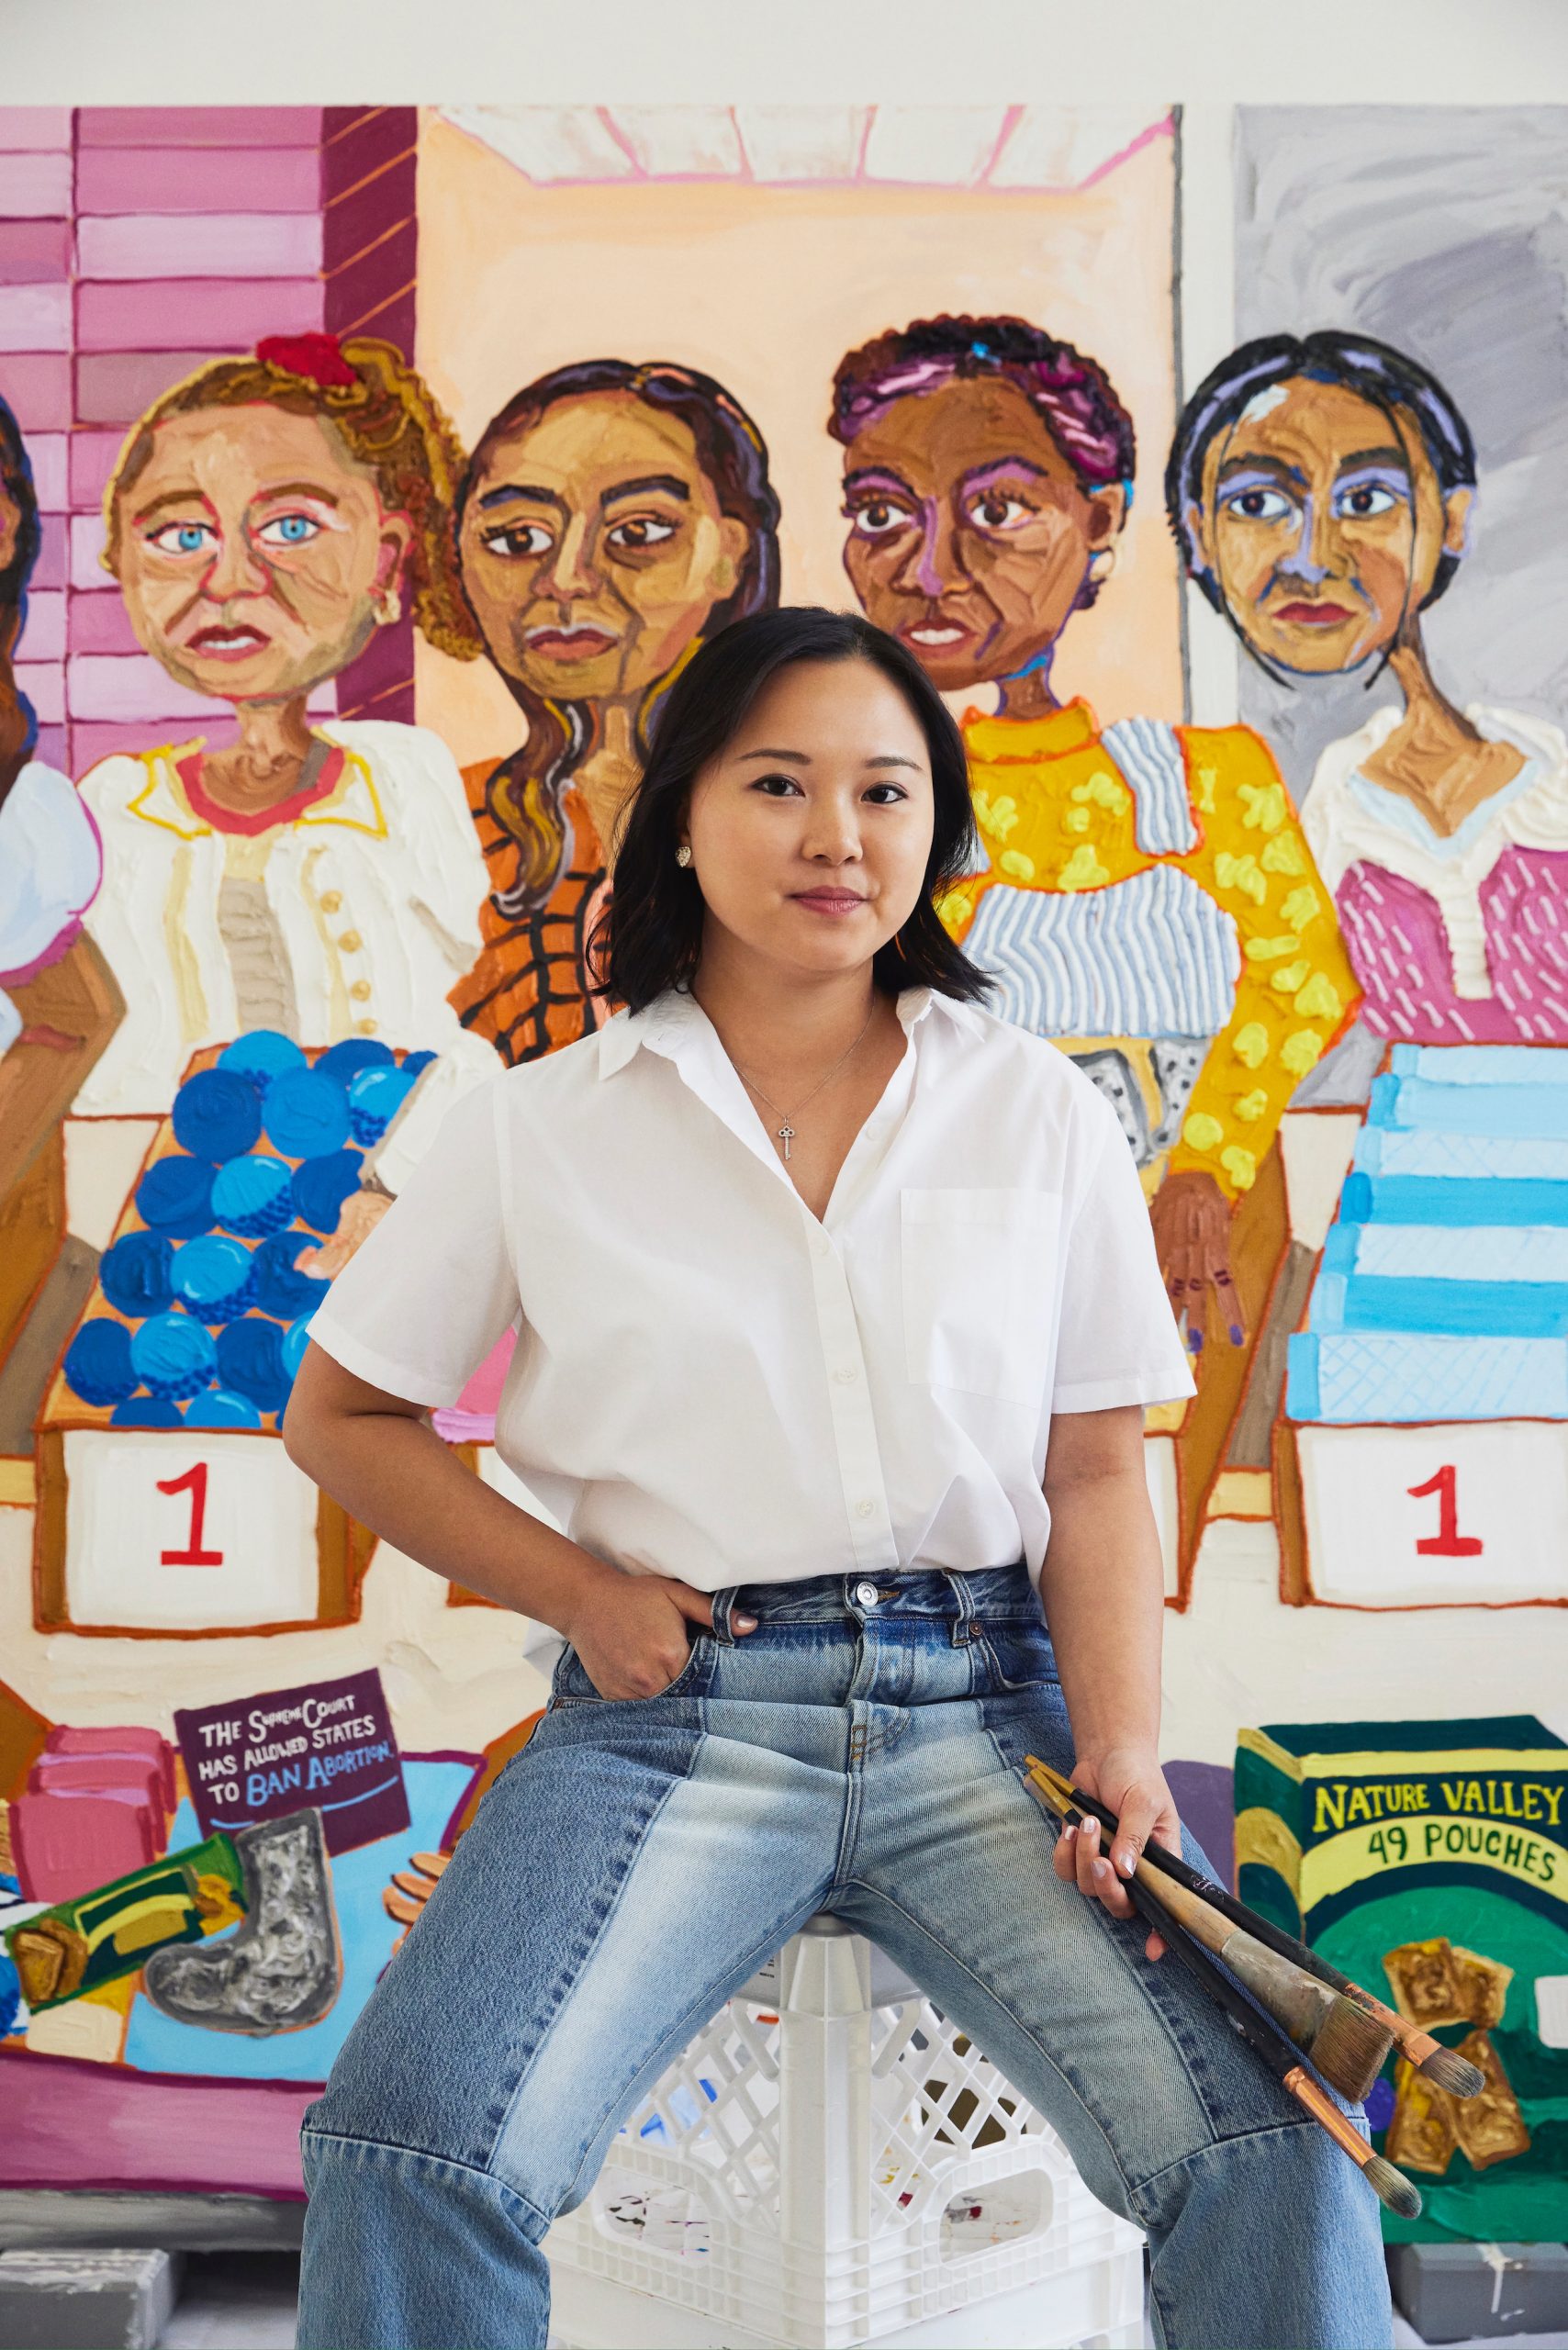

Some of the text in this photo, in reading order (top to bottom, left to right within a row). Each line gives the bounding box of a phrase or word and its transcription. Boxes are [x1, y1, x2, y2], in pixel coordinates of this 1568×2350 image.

[156, 1461, 223, 1566] 1
[1406, 1464, 1484, 1557] 1
[198, 1720, 242, 1748] THE
[302, 1695, 355, 1729] COURT
[198, 1715, 376, 1781] HAS ALLOWED STATES
[207, 1782, 241, 1805] TO
[246, 1762, 303, 1807] BAN
[1312, 1779, 1564, 1833] NATURE VALLEY
[1368, 1823, 1556, 1882] 49 POUCHES
